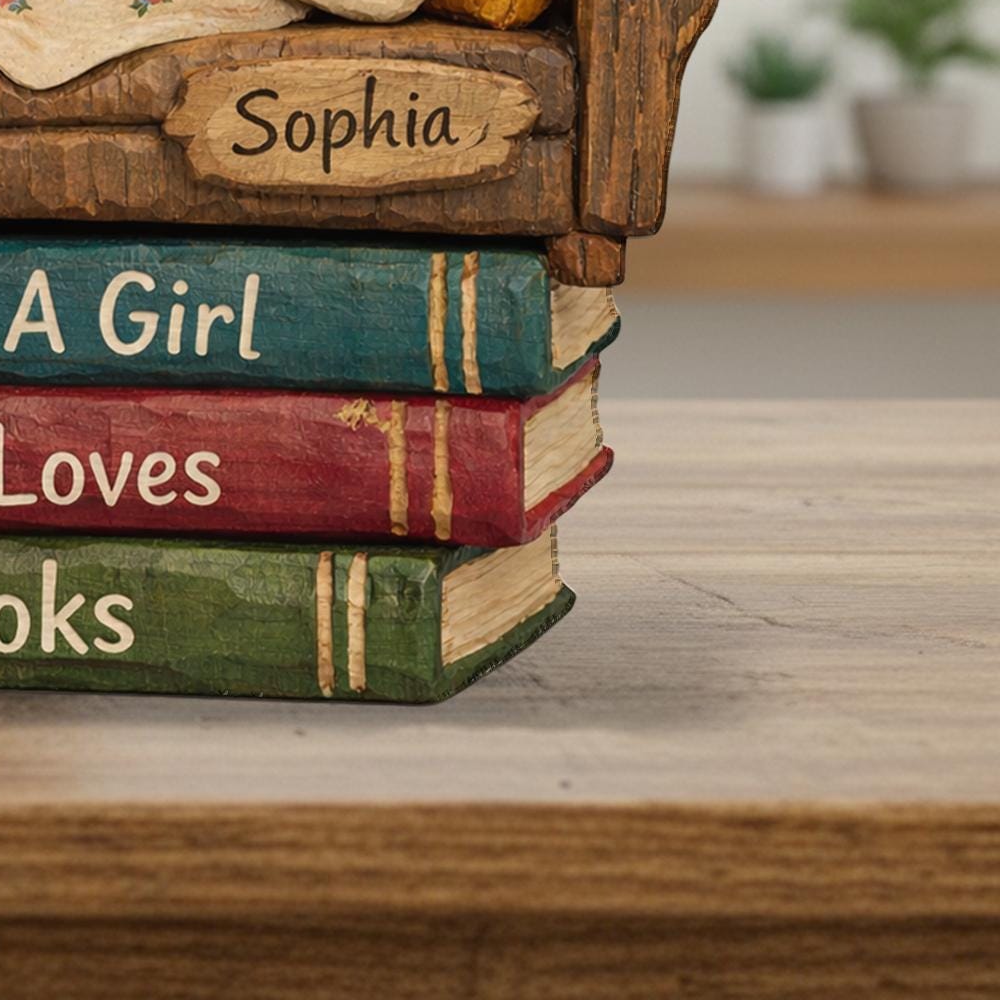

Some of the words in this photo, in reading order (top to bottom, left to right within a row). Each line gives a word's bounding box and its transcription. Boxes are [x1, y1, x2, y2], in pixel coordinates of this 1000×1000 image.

[231, 75, 460, 174] Sophia
[3, 269, 65, 354] A
[98, 270, 261, 360] Girl
